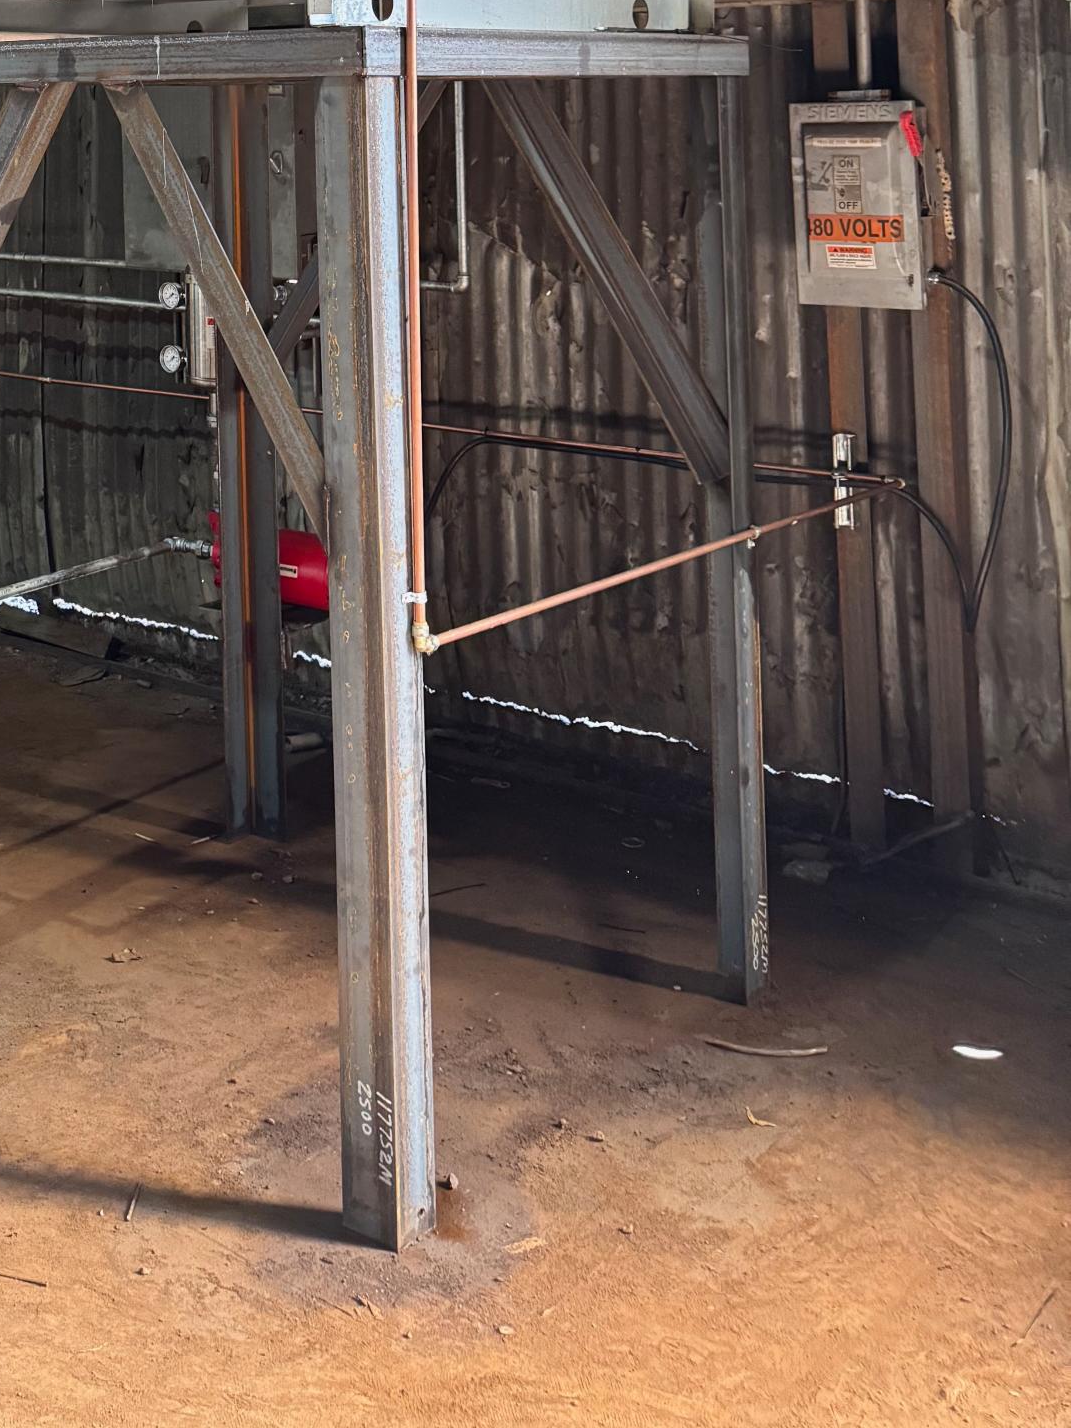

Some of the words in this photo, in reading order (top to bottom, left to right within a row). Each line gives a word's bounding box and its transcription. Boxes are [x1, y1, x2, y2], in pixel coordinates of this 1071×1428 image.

[808, 103, 891, 120] SIEMENS
[838, 159, 854, 168] ON
[838, 201, 858, 210] OFF
[839, 218, 902, 239] VOLTS
[357, 1080, 373, 1135] 2500
[375, 1091, 395, 1187] 117752M
